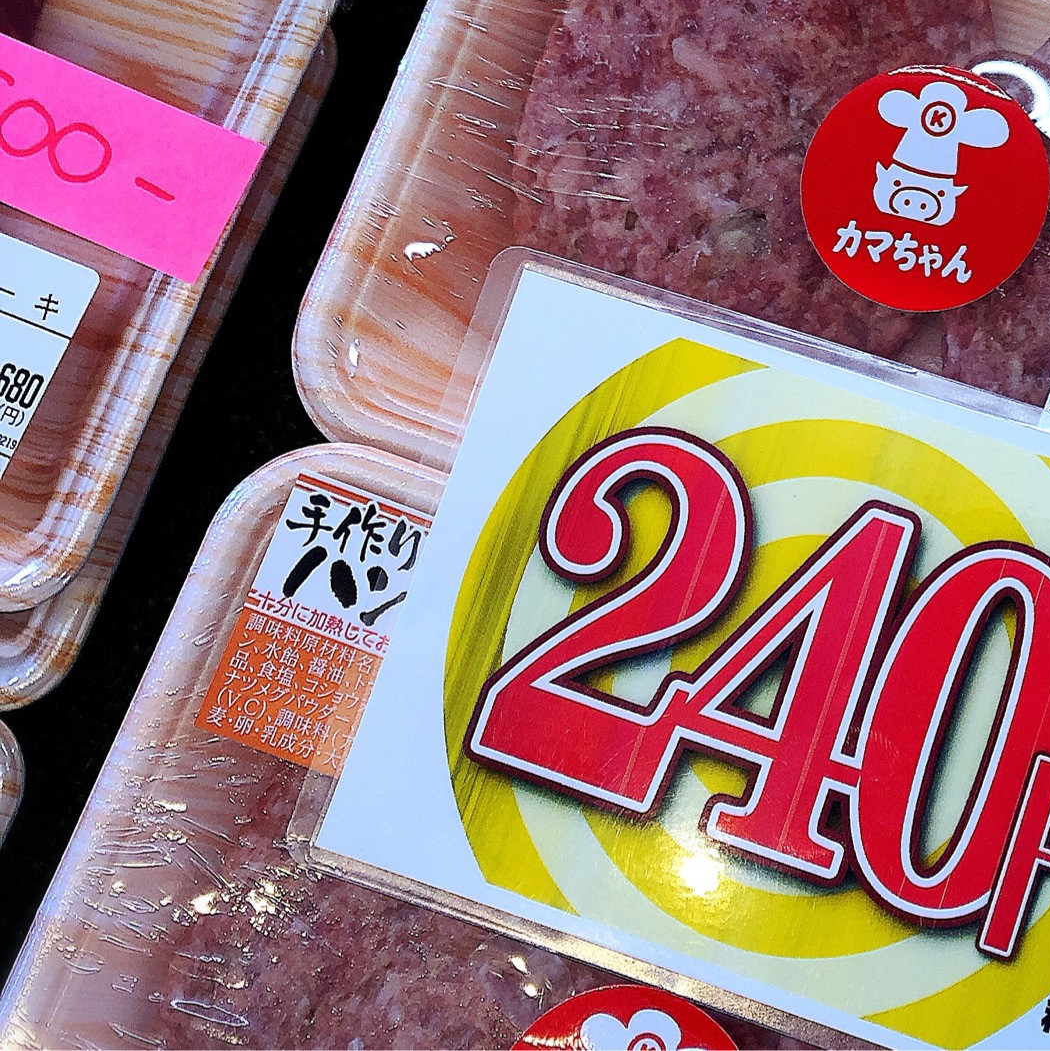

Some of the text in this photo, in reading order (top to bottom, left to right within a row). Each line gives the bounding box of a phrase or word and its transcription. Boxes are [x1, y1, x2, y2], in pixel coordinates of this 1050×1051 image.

[0, 68, 175, 202] 00-
[930, 110, 947, 128] K
[832, 220, 973, 284] カマちゃん
[286, 494, 422, 571] 手作り
[282, 545, 408, 627] ハン
